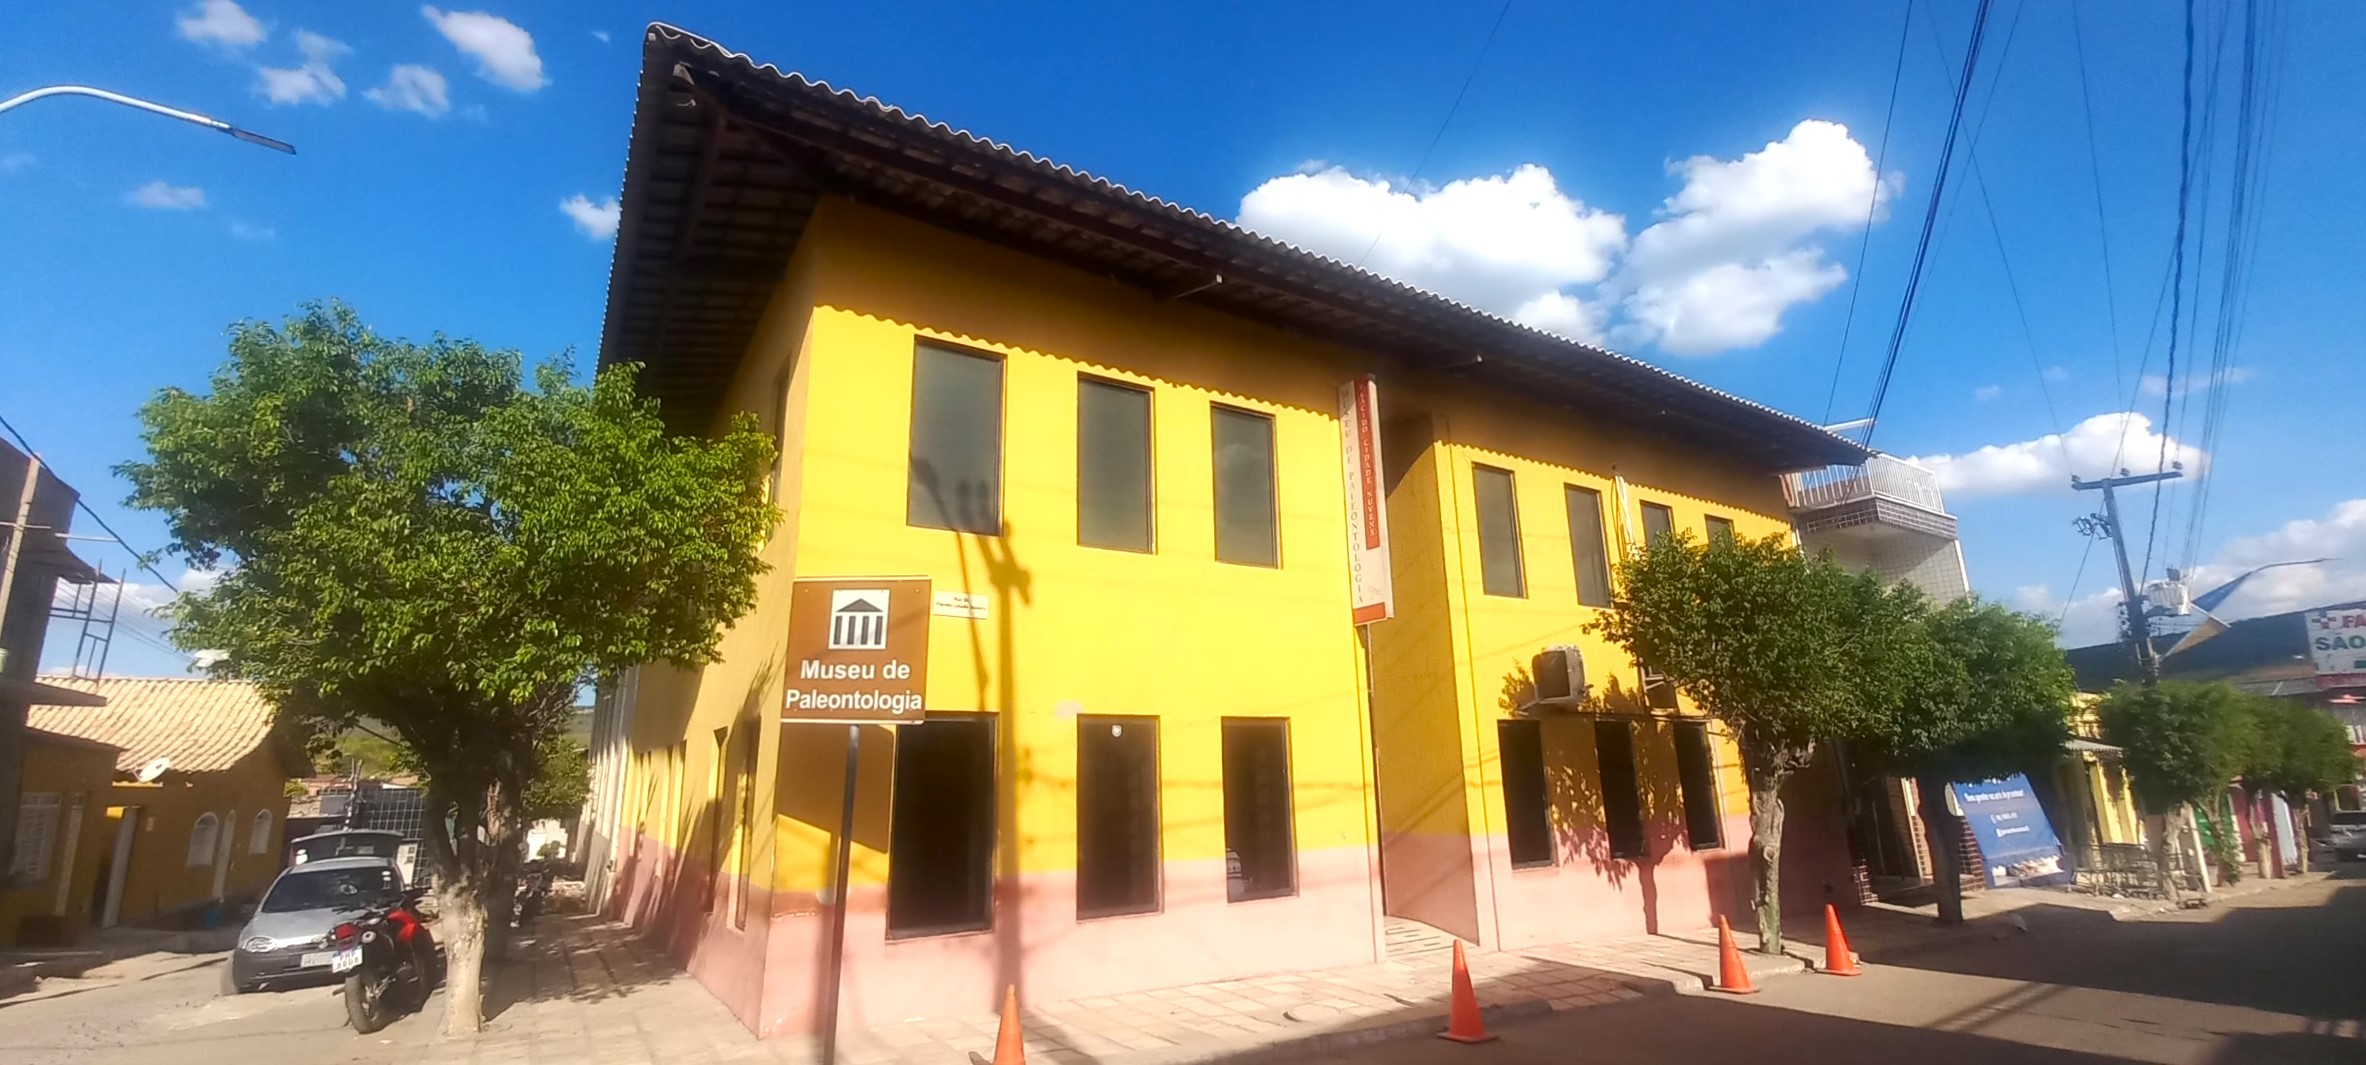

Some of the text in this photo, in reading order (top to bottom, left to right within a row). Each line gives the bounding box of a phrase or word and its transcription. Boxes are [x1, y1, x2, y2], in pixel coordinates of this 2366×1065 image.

[1363, 438, 1372, 485] CIDADE
[1367, 490, 1376, 537] NUVENS
[1349, 471, 1364, 604] PALEONTOLOGIA
[2315, 632, 2366, 651] SÃO
[800, 659, 911, 680] Museu de
[785, 688, 923, 715] Paleontologia
